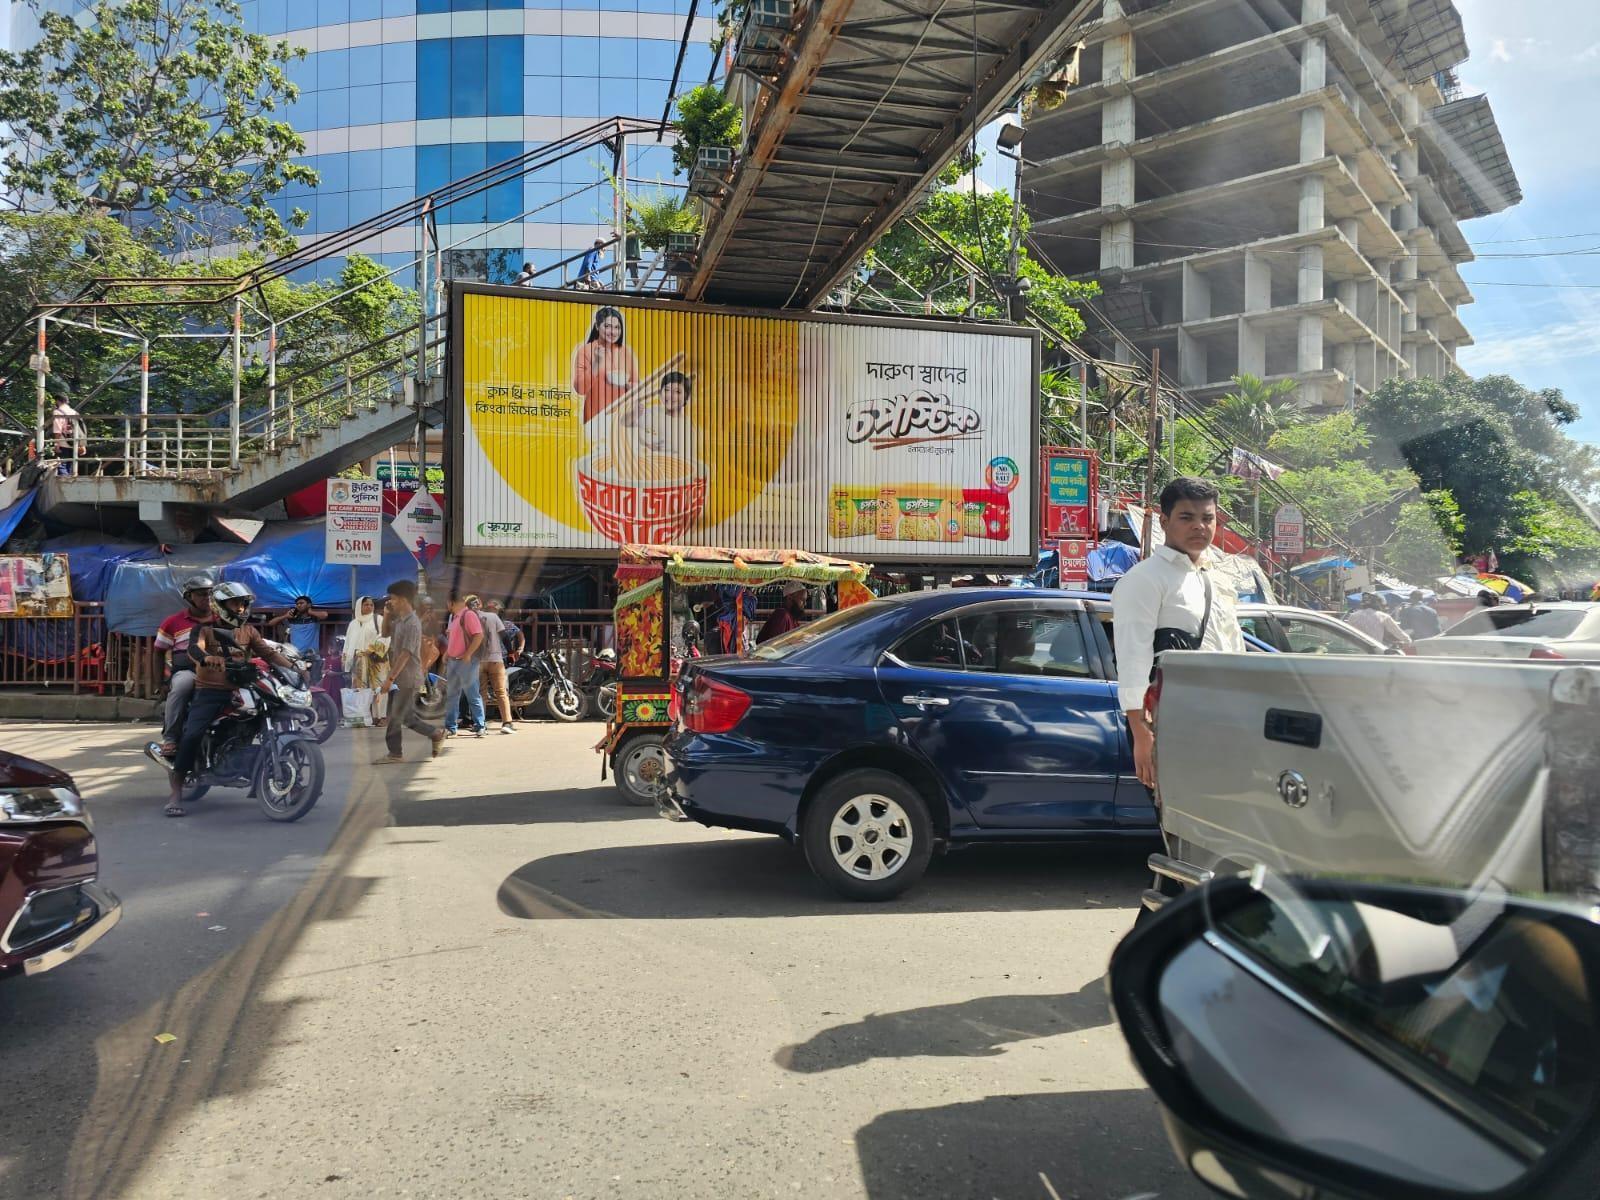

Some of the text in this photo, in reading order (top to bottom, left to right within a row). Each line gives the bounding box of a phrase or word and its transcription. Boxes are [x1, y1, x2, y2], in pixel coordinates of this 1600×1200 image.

[866, 362, 968, 385] দারুণ স্বাদের
[487, 386, 509, 399] ক্লাস
[475, 400, 506, 414] কিংবা
[508, 402, 538, 416] মিসের
[351, 493, 378, 504] পুলিশ
[578, 470, 637, 518] সবার
[487, 522, 523, 533] স্কয়ার
[336, 539, 371, 553] KSRM
[1062, 556, 1087, 568] টয়লেট
